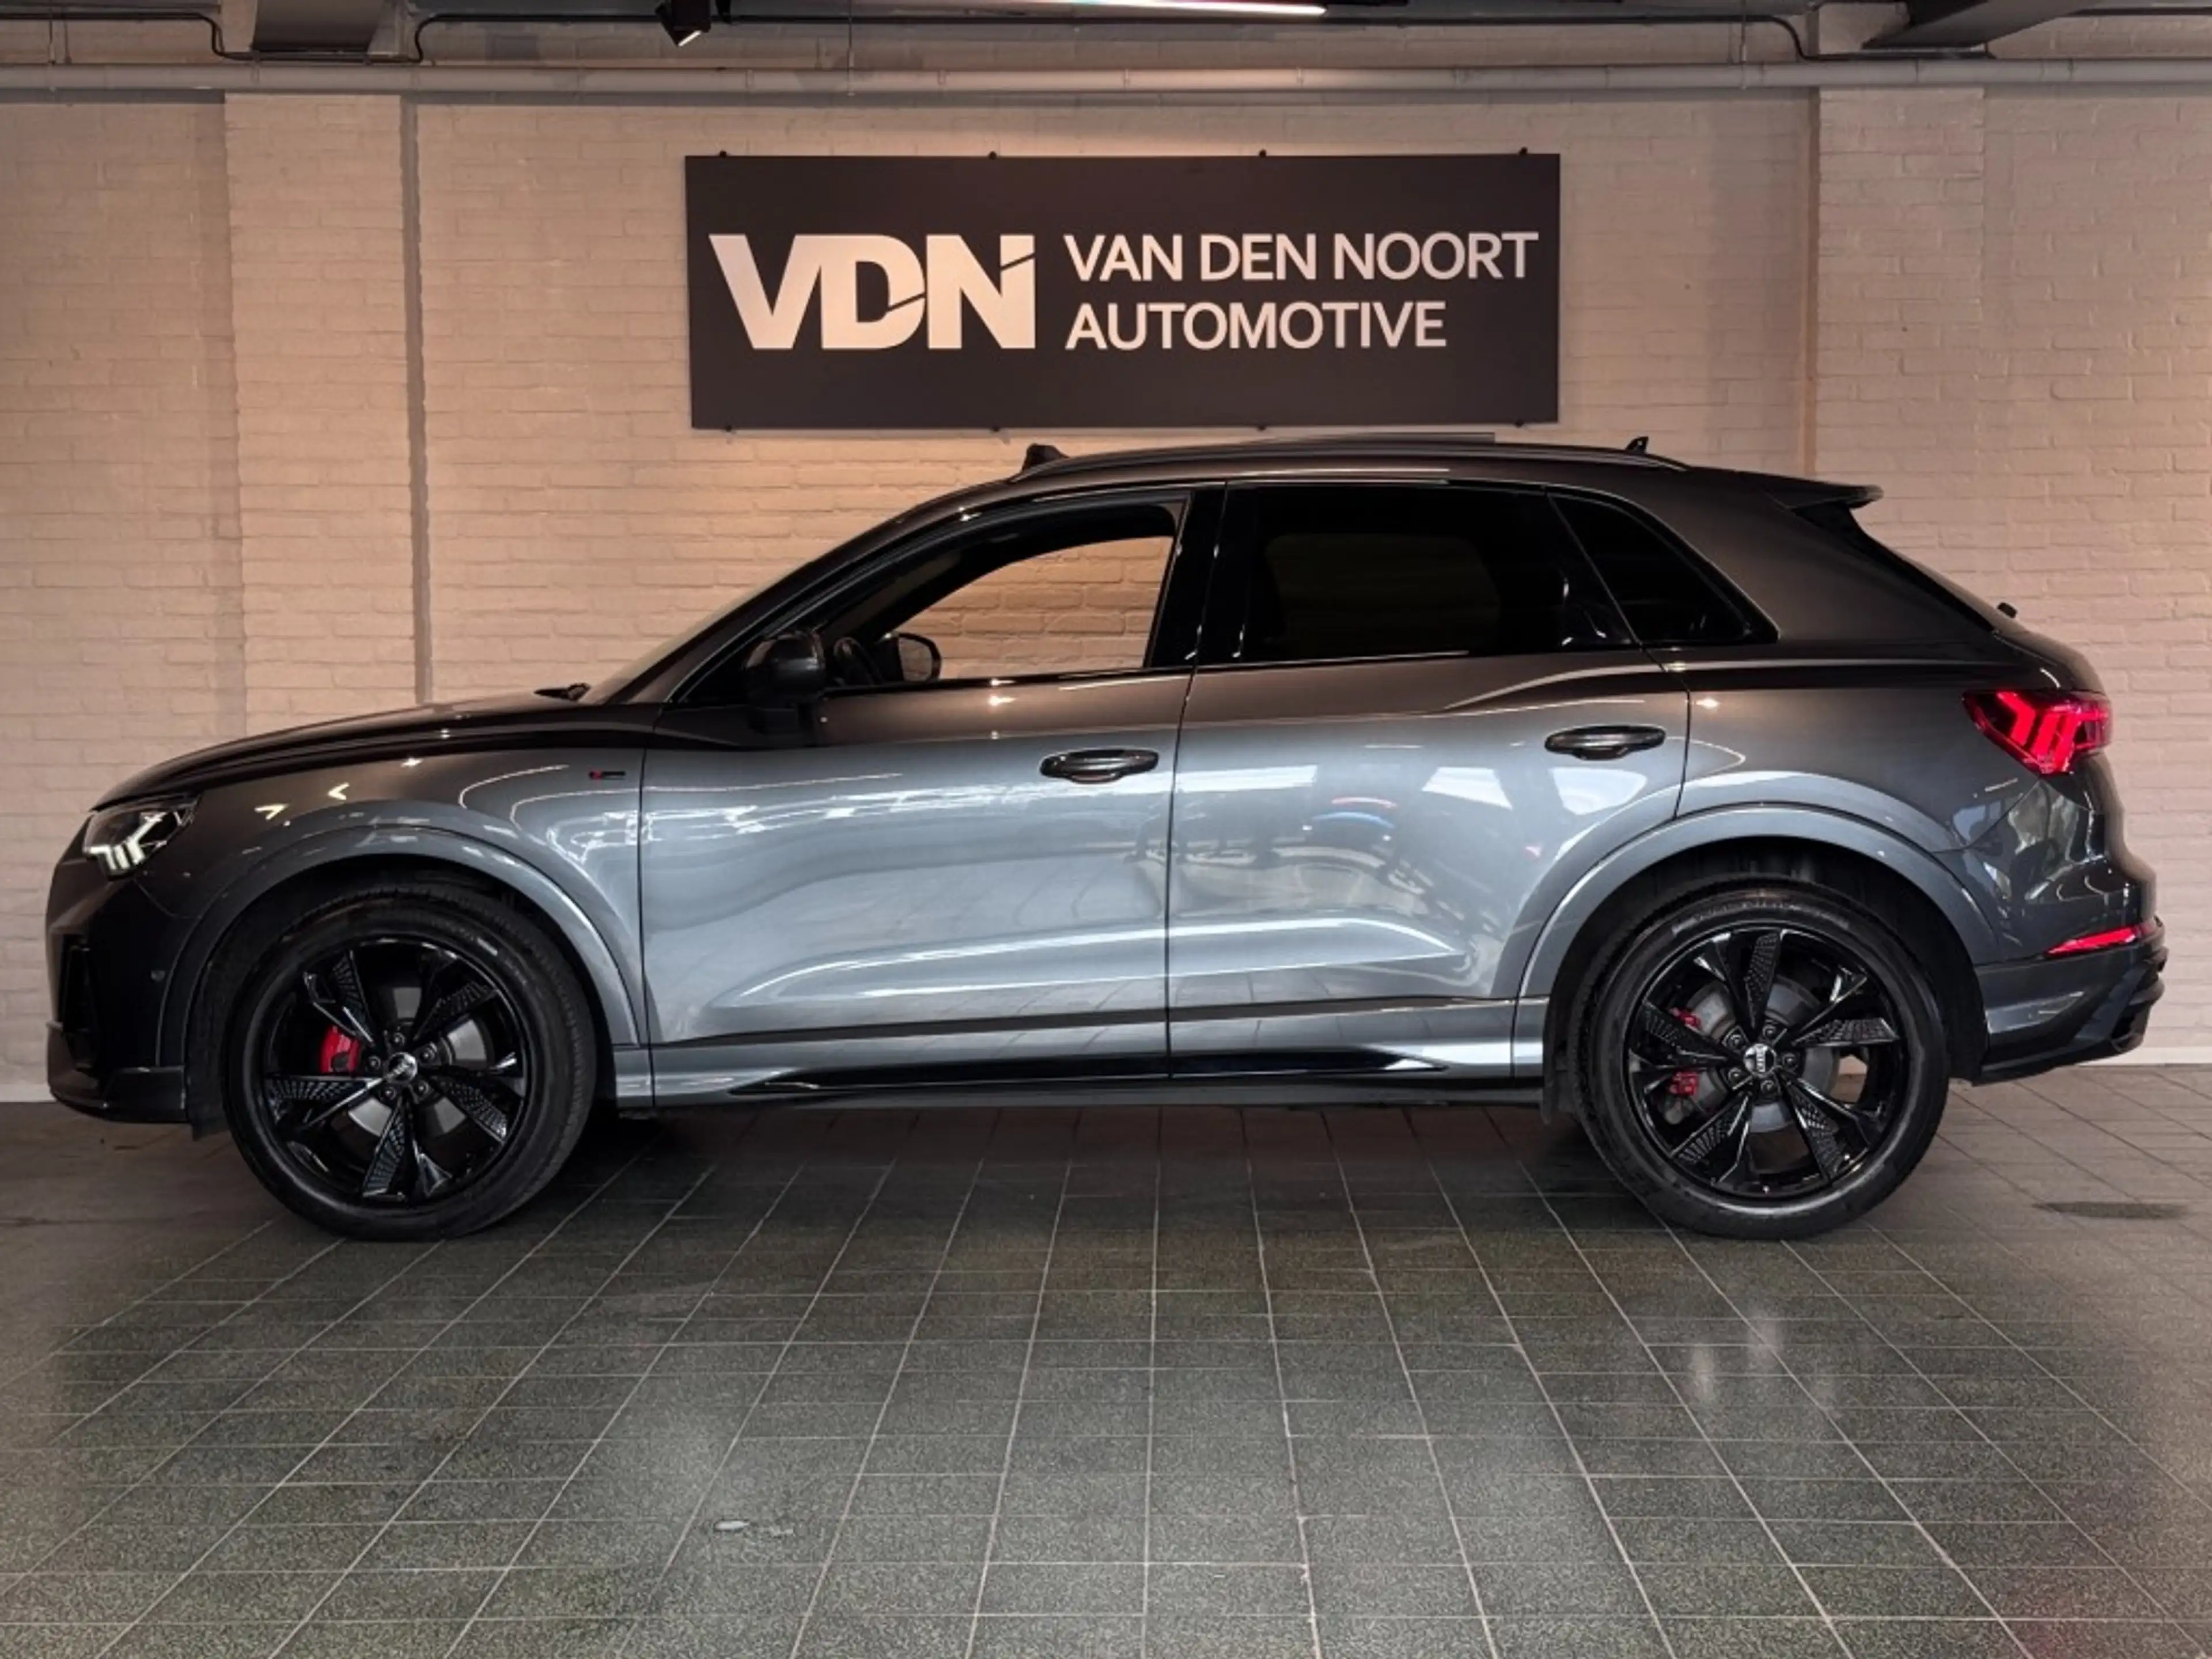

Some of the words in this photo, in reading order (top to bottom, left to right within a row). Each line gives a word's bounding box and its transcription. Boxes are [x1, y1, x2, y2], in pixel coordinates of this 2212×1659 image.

[1063, 234, 1183, 282] VAN
[1200, 233, 1316, 281] DEN
[1334, 232, 1539, 280] NOORT
[709, 234, 1036, 350] VDN
[1065, 301, 1446, 350] AUTOMOTIVE
